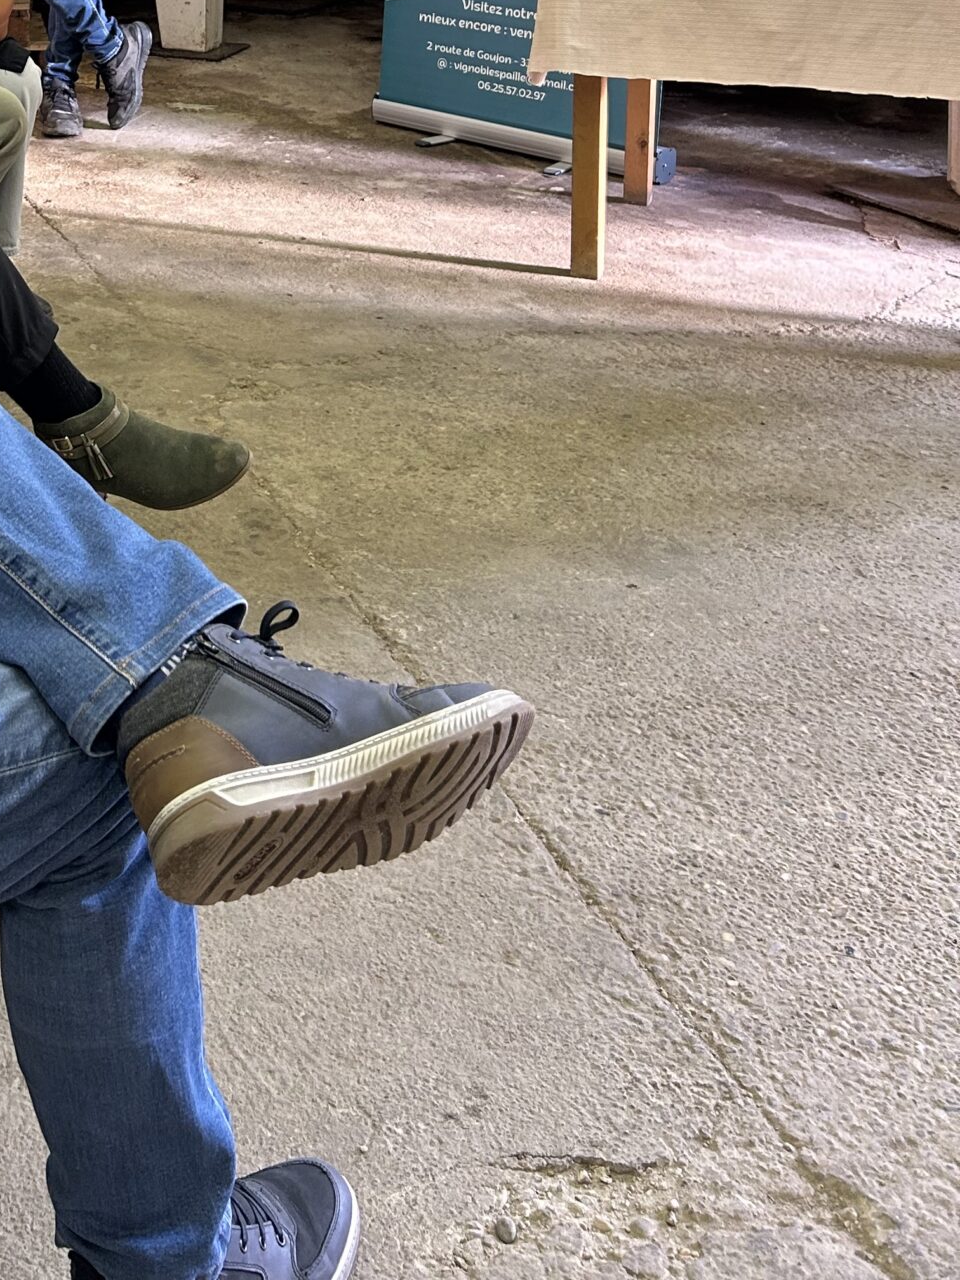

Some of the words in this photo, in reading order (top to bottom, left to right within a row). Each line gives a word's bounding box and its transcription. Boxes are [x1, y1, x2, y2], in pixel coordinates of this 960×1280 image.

[462, 0, 503, 16] Visitez
[418, 12, 457, 27] mieux
[458, 18, 502, 35] encore
[510, 26, 535, 40] ven
[426, 41, 434, 51] 2
[434, 42, 462, 57] route
[463, 47, 476, 59] de
[477, 50, 512, 67] Goujon
[436, 57, 448, 70] @
[477, 80, 546, 101] 06.25.57.02.97
